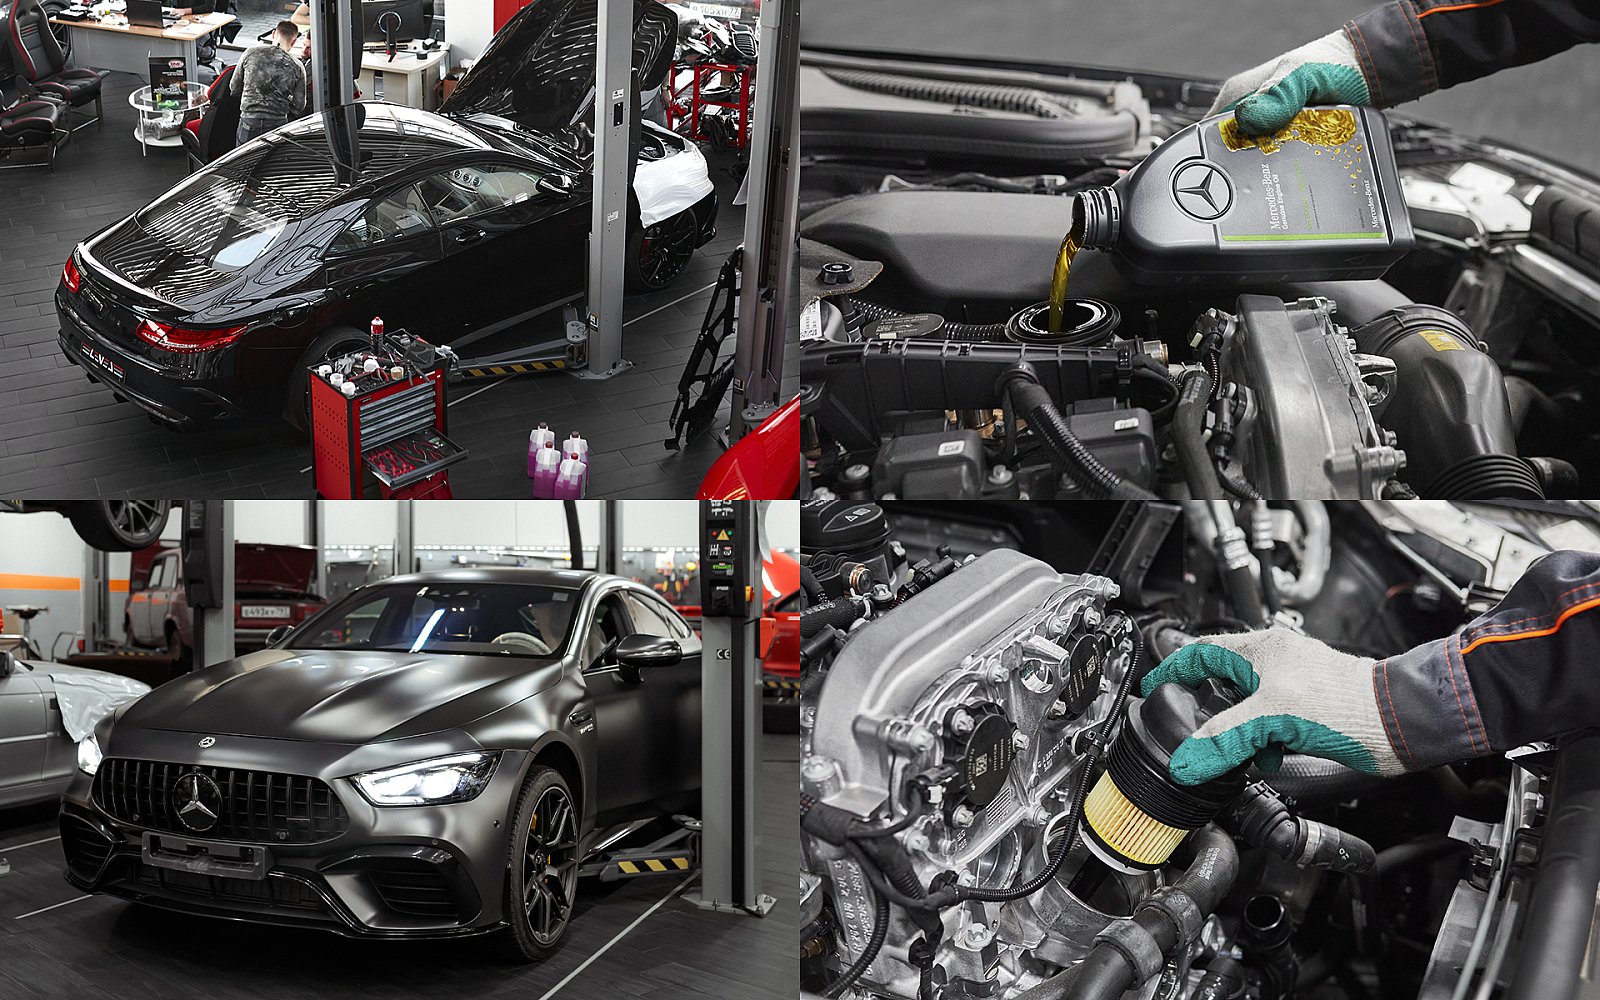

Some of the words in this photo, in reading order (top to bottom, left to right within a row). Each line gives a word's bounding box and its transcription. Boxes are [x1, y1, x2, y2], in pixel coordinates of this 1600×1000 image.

[1261, 163, 1281, 230] Mercedes-Benz
[1275, 183, 1284, 204] Engine
[1279, 205, 1289, 230] Genuine
[716, 649, 726, 659] CE
